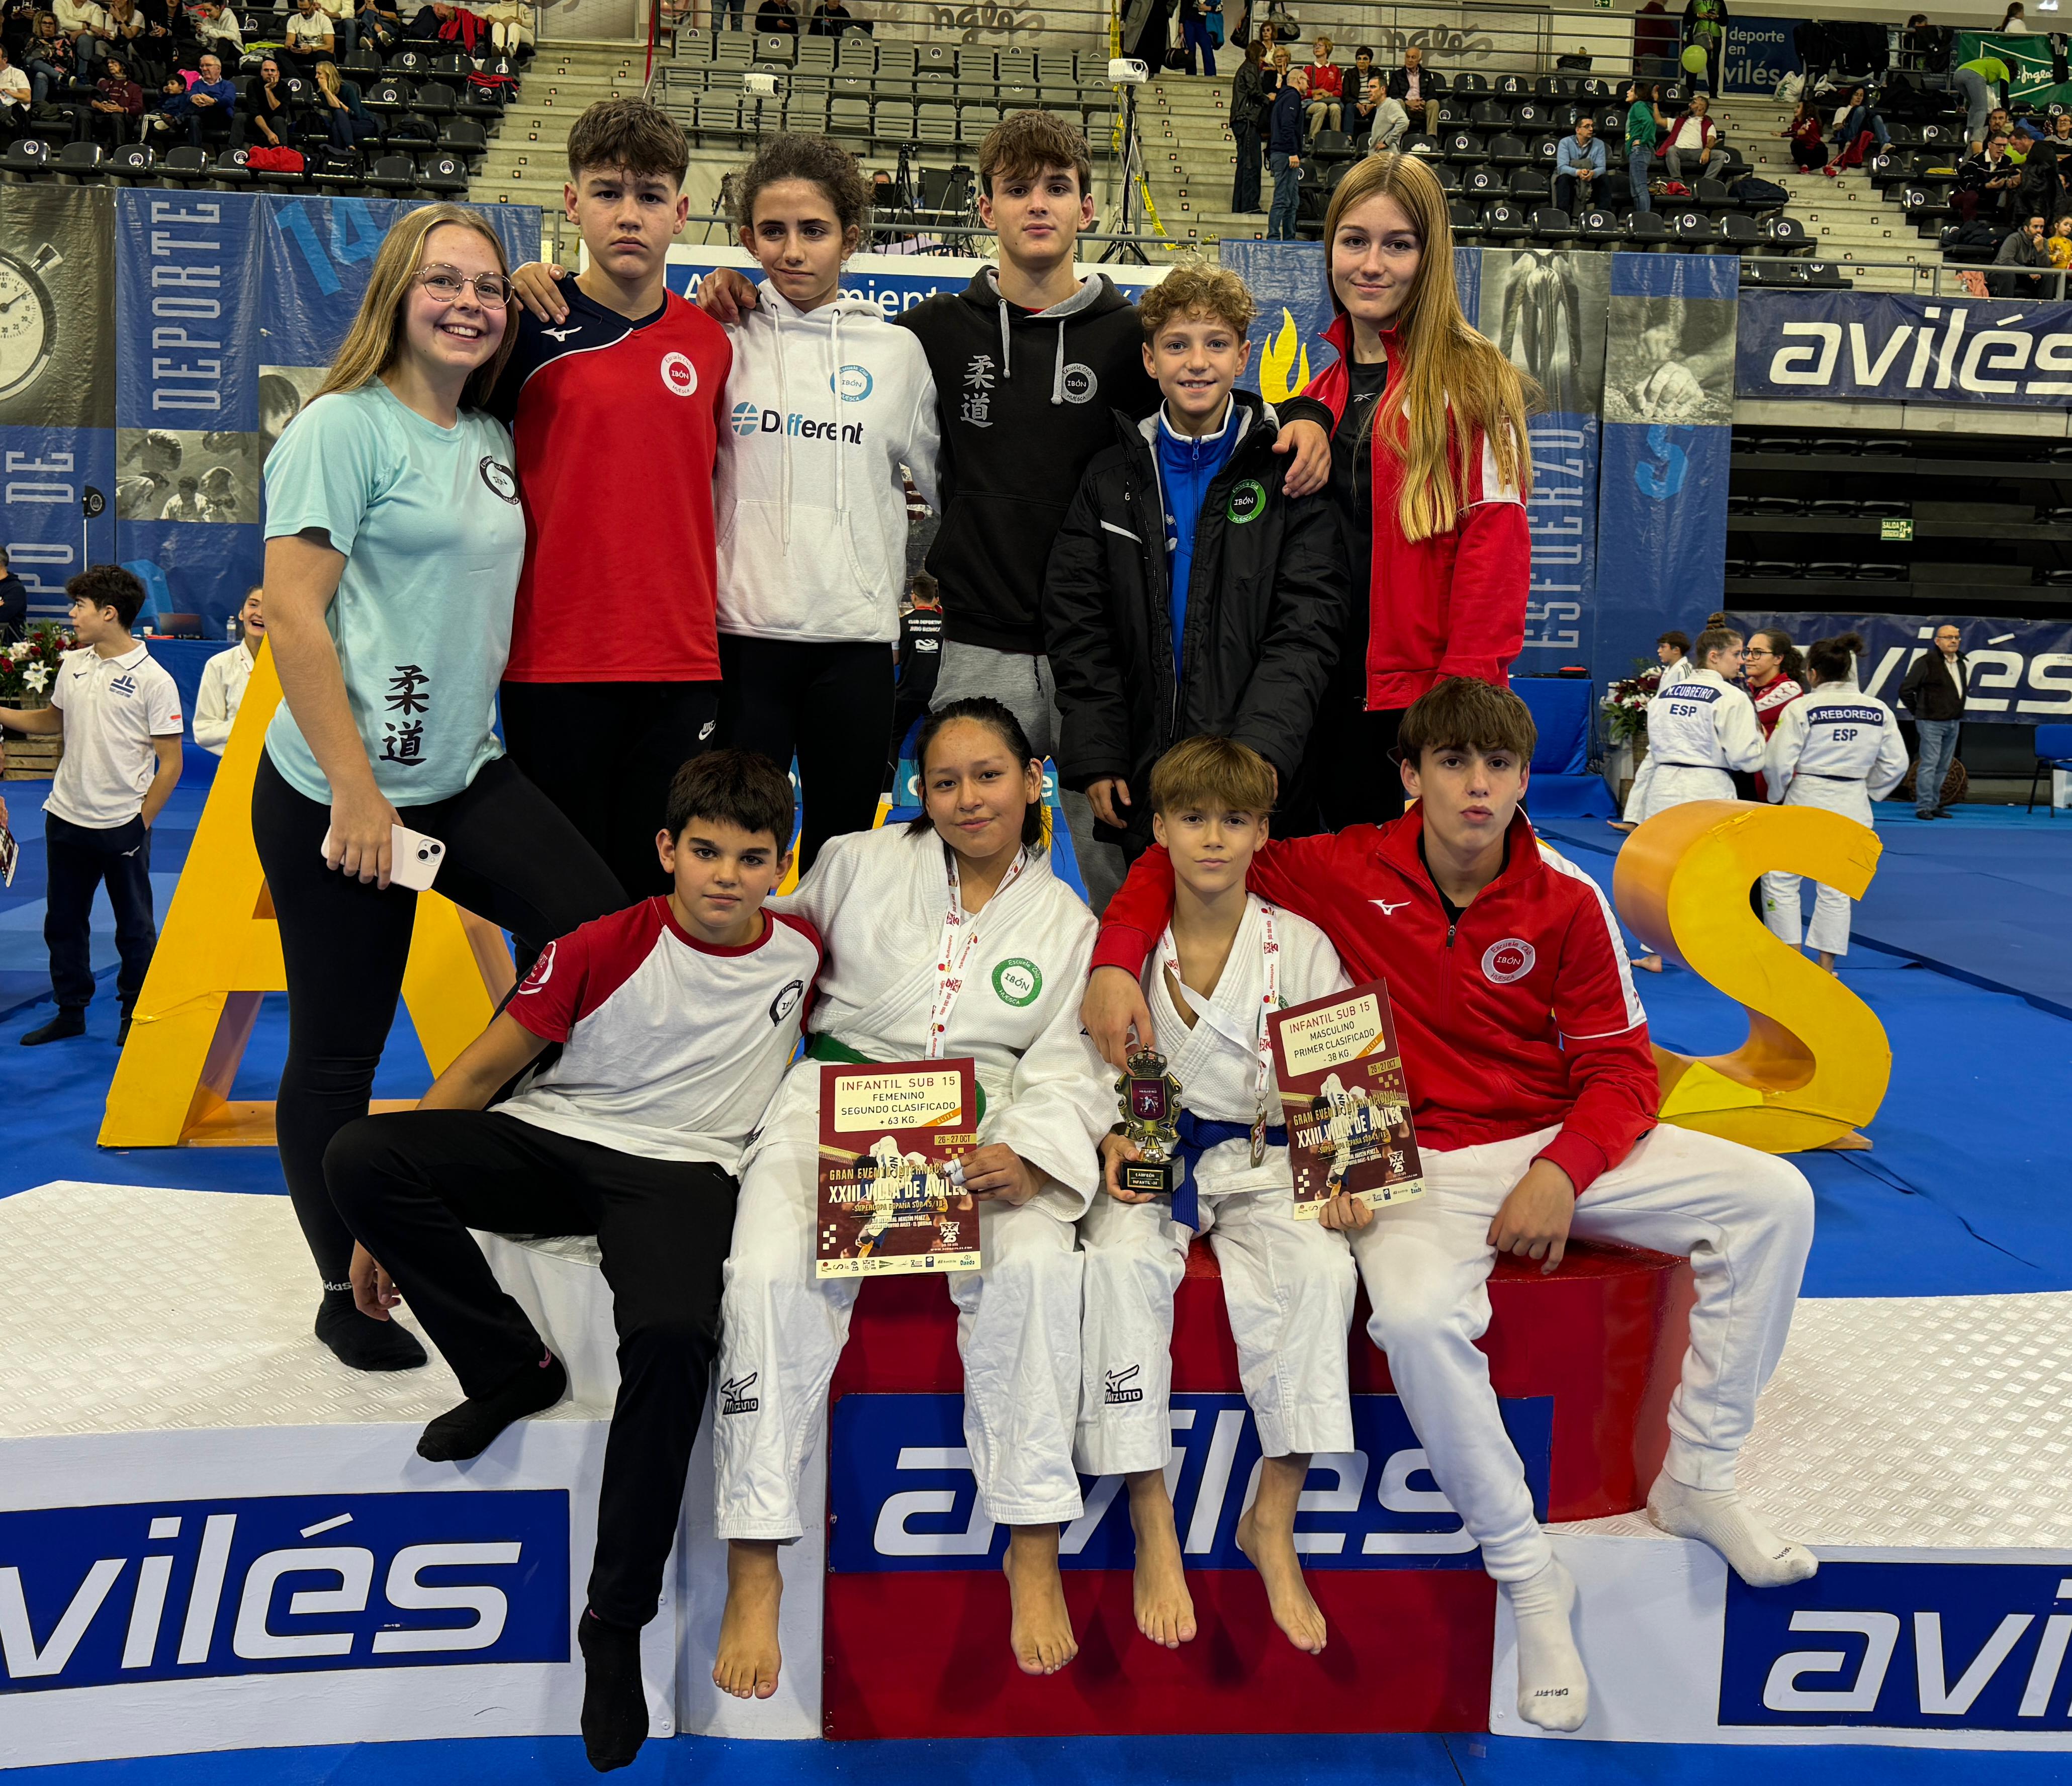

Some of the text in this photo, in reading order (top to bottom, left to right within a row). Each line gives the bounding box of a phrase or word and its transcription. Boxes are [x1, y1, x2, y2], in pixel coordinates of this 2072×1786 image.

[1729, 26, 1785, 44] deporte
[1728, 45, 1746, 55] en
[151, 202, 221, 410] DEPORTE
[841, 380, 862, 388] IBÓN
[1067, 379, 1087, 387] IBÓN
[960, 354, 996, 428] 柔道
[6, 452, 74, 504] DE
[1234, 496, 1253, 506] IBÓN
[1523, 429, 1584, 649] ESFUERZO
[1665, 686, 1714, 700] M.CUBREIRO
[379, 665, 430, 766] 柔道
[1669, 704, 1697, 717] ESP
[1833, 729, 1858, 742] ESP
[1496, 956, 1521, 965] IBÓN
[1004, 973, 1030, 992] IBÓN
[1490, 973, 1515, 982] HUESCA
[1289, 1001, 1370, 1034] INFANTIL SUB 15
[1310, 1021, 1355, 1041] MASCULINO
[1294, 1043, 1324, 1058] PRIMER
[1325, 1028, 1375, 1049] CLASIFICADO
[1328, 1054, 1337, 1062] 38
[1339, 1049, 1352, 1059] KG.
[842, 1077, 955, 1091] INFANTIL SUB 15
[873, 1091, 924, 1102] FEMENINO
[841, 1102, 955, 1115] SEGUNDO CLASIFICADO
[888, 1117, 898, 1125] 63
[902, 1116, 917, 1124] KG.
[1293, 1111, 1313, 1126] GRAN
[1296, 1126, 1323, 1149] XXIII
[1355, 1115, 1368, 1134] DE
[830, 1169, 854, 1181] GRAN
[829, 1184, 861, 1203] XXIII
[864, 1180, 900, 1201] VILLA
[905, 1180, 920, 1199] DE
[943, 1232, 956, 1243] 25
